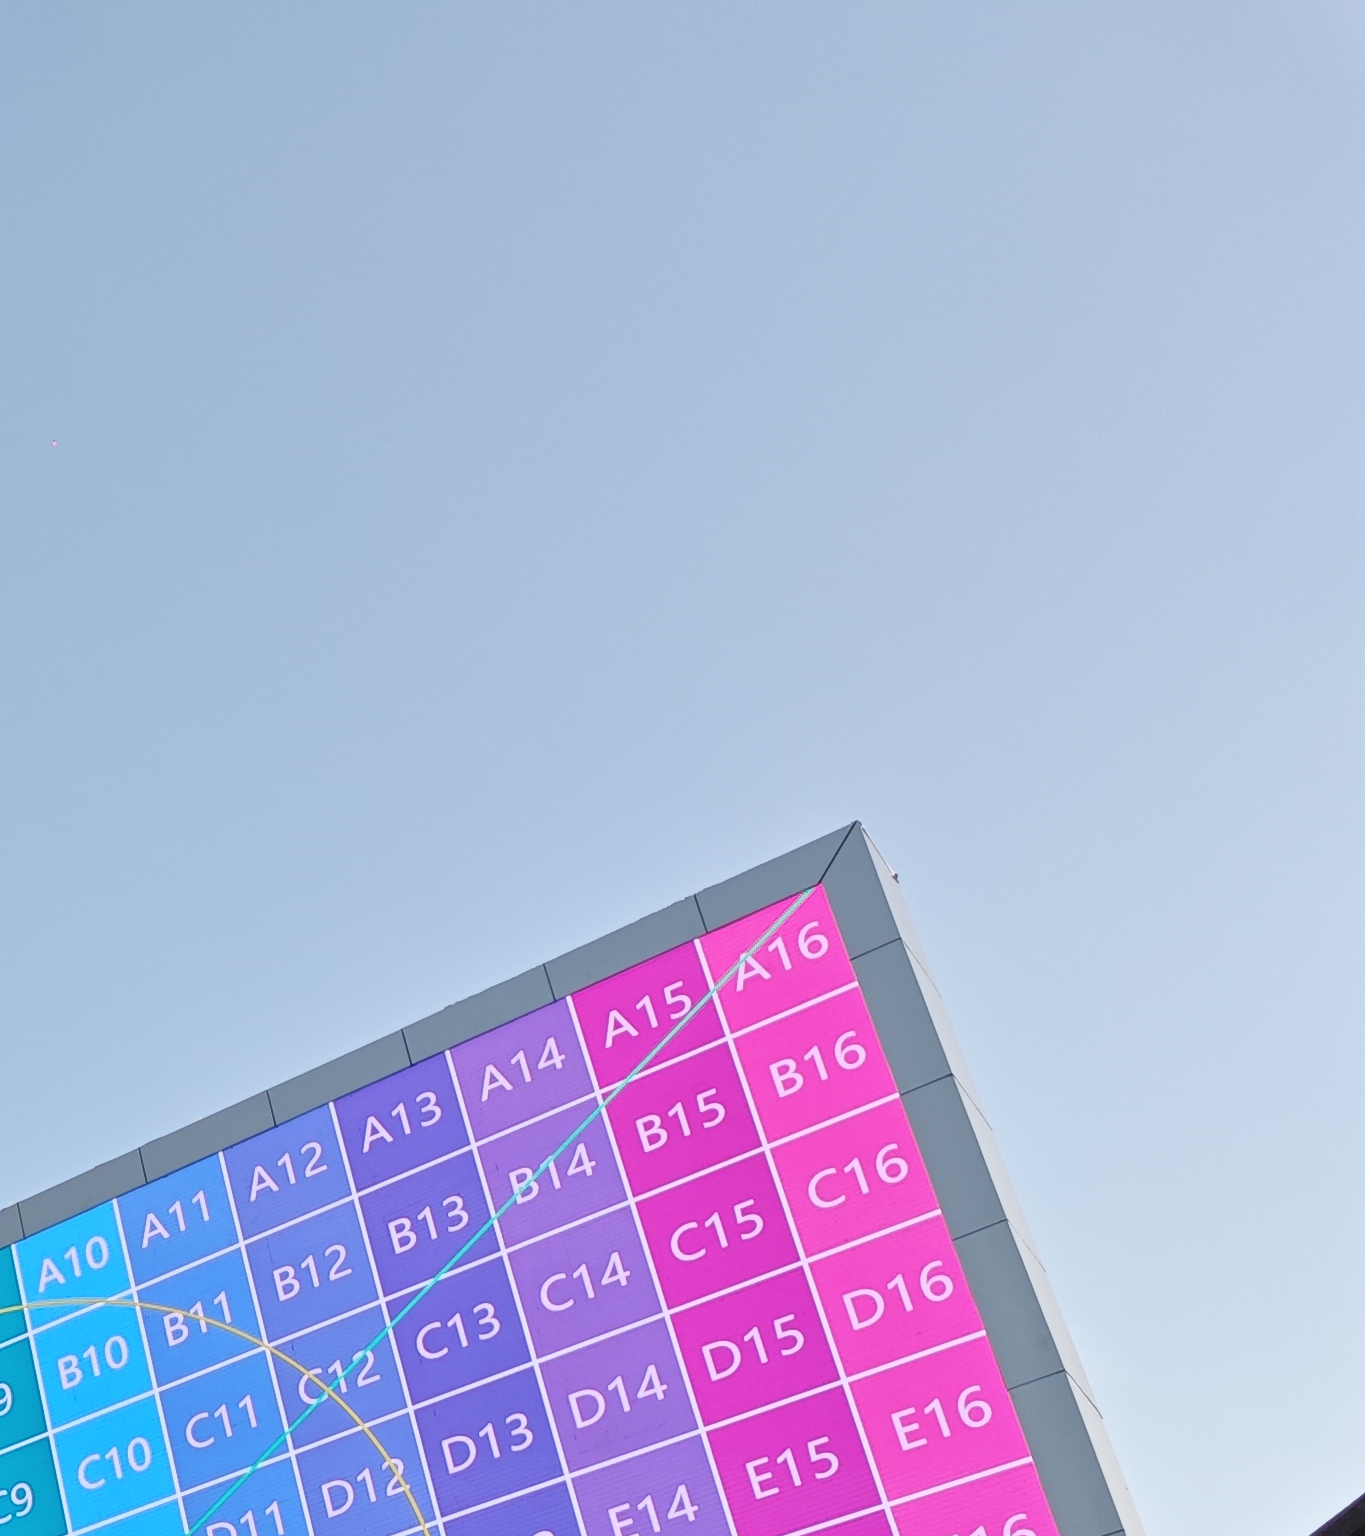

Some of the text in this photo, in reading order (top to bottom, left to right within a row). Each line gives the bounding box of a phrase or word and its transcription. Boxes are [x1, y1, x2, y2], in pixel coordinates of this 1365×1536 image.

[37, 1235, 109, 1293] A10
[140, 1189, 210, 1249] A11
[249, 1140, 328, 1202] A12
[361, 1090, 442, 1153] A13
[480, 1036, 566, 1102] A14
[604, 979, 696, 1049] A15
[735, 920, 829, 993] A16
[56, 1334, 129, 1390] B10
[162, 1289, 232, 1347] B11
[272, 1243, 352, 1302] B12
[387, 1194, 469, 1254] B13
[508, 1142, 596, 1206] B14
[634, 1087, 726, 1153] B15
[768, 1029, 866, 1098] B16
[76, 1436, 152, 1490] C10
[184, 1393, 258, 1449] C11
[297, 1350, 381, 1405] C12
[415, 1301, 500, 1360] C13
[539, 1250, 631, 1312] C14
[669, 1198, 764, 1261] C15
[806, 1142, 909, 1208] C16
[320, 1457, 410, 1518] D12
[440, 1412, 534, 1475] D13
[567, 1363, 668, 1429] D14
[700, 1313, 805, 1382] D15
[842, 1259, 954, 1331] D16
[744, 1435, 839, 1500] E15
[890, 1384, 992, 1451] E16
